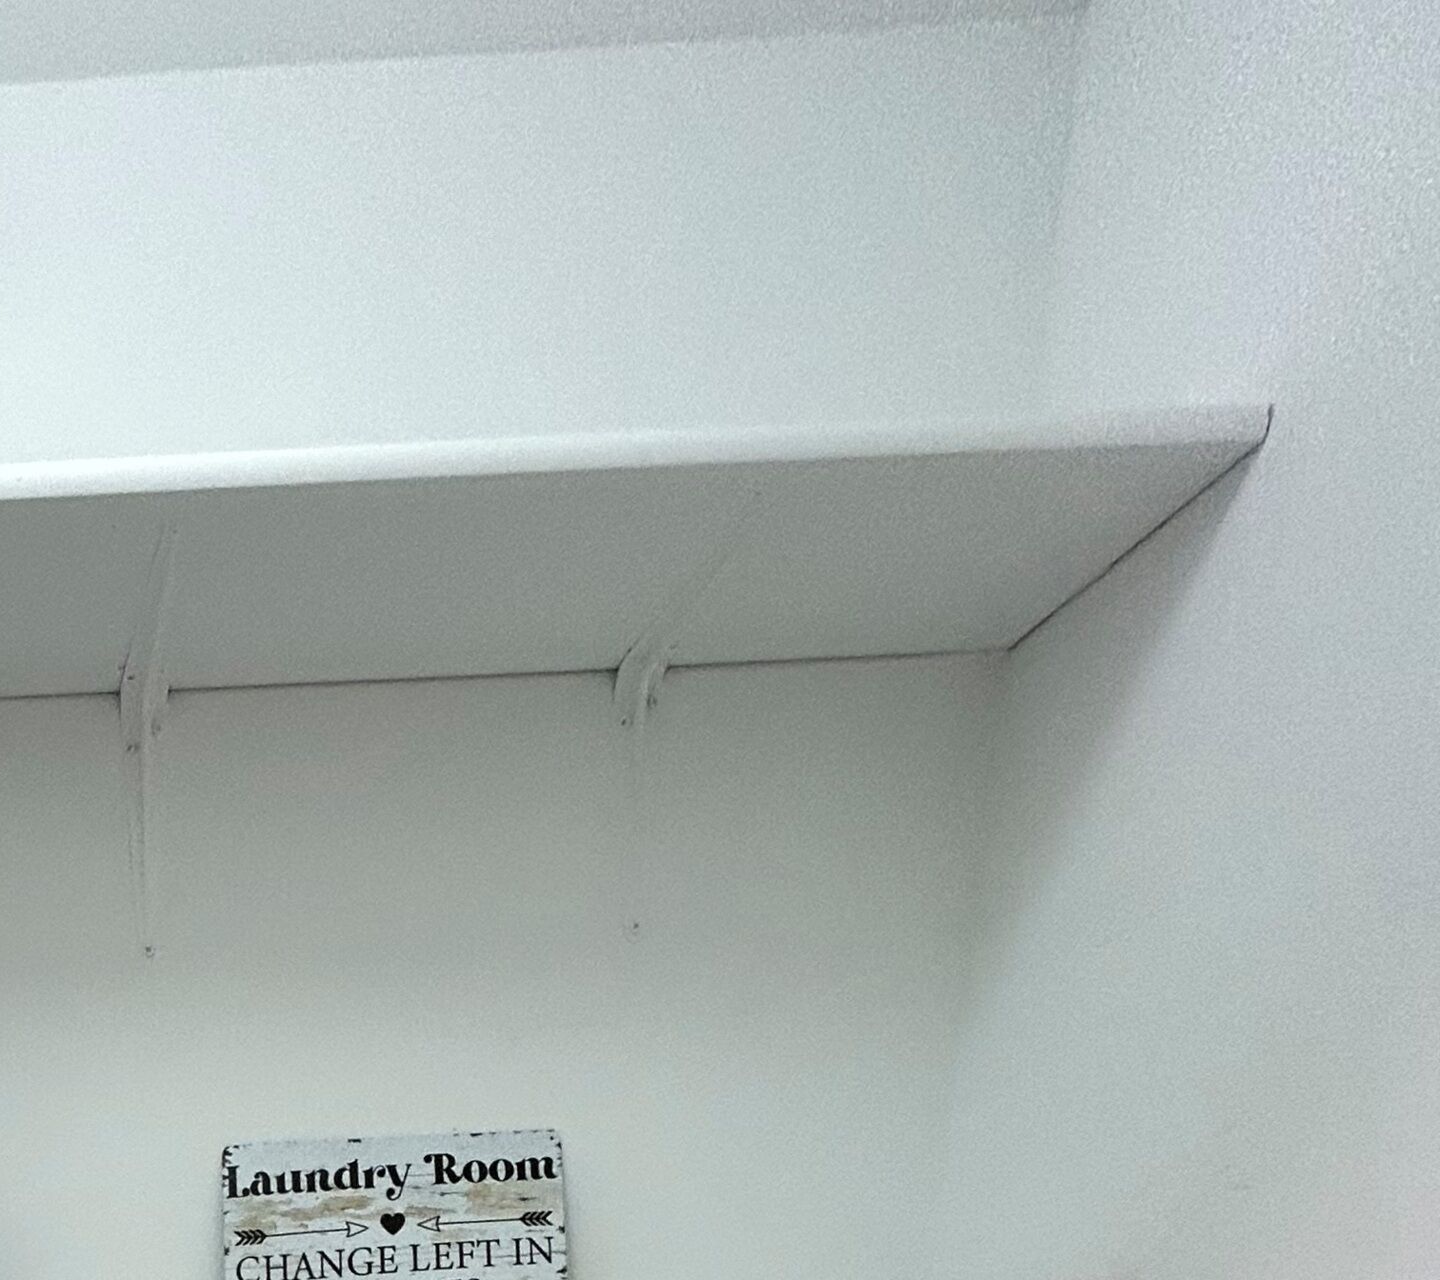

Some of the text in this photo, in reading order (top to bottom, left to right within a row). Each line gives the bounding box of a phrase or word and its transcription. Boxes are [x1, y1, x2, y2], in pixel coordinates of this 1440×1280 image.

[227, 1152, 558, 1201] Laundry Room
[409, 1238, 500, 1273] LEFT
[512, 1236, 554, 1266] IN
